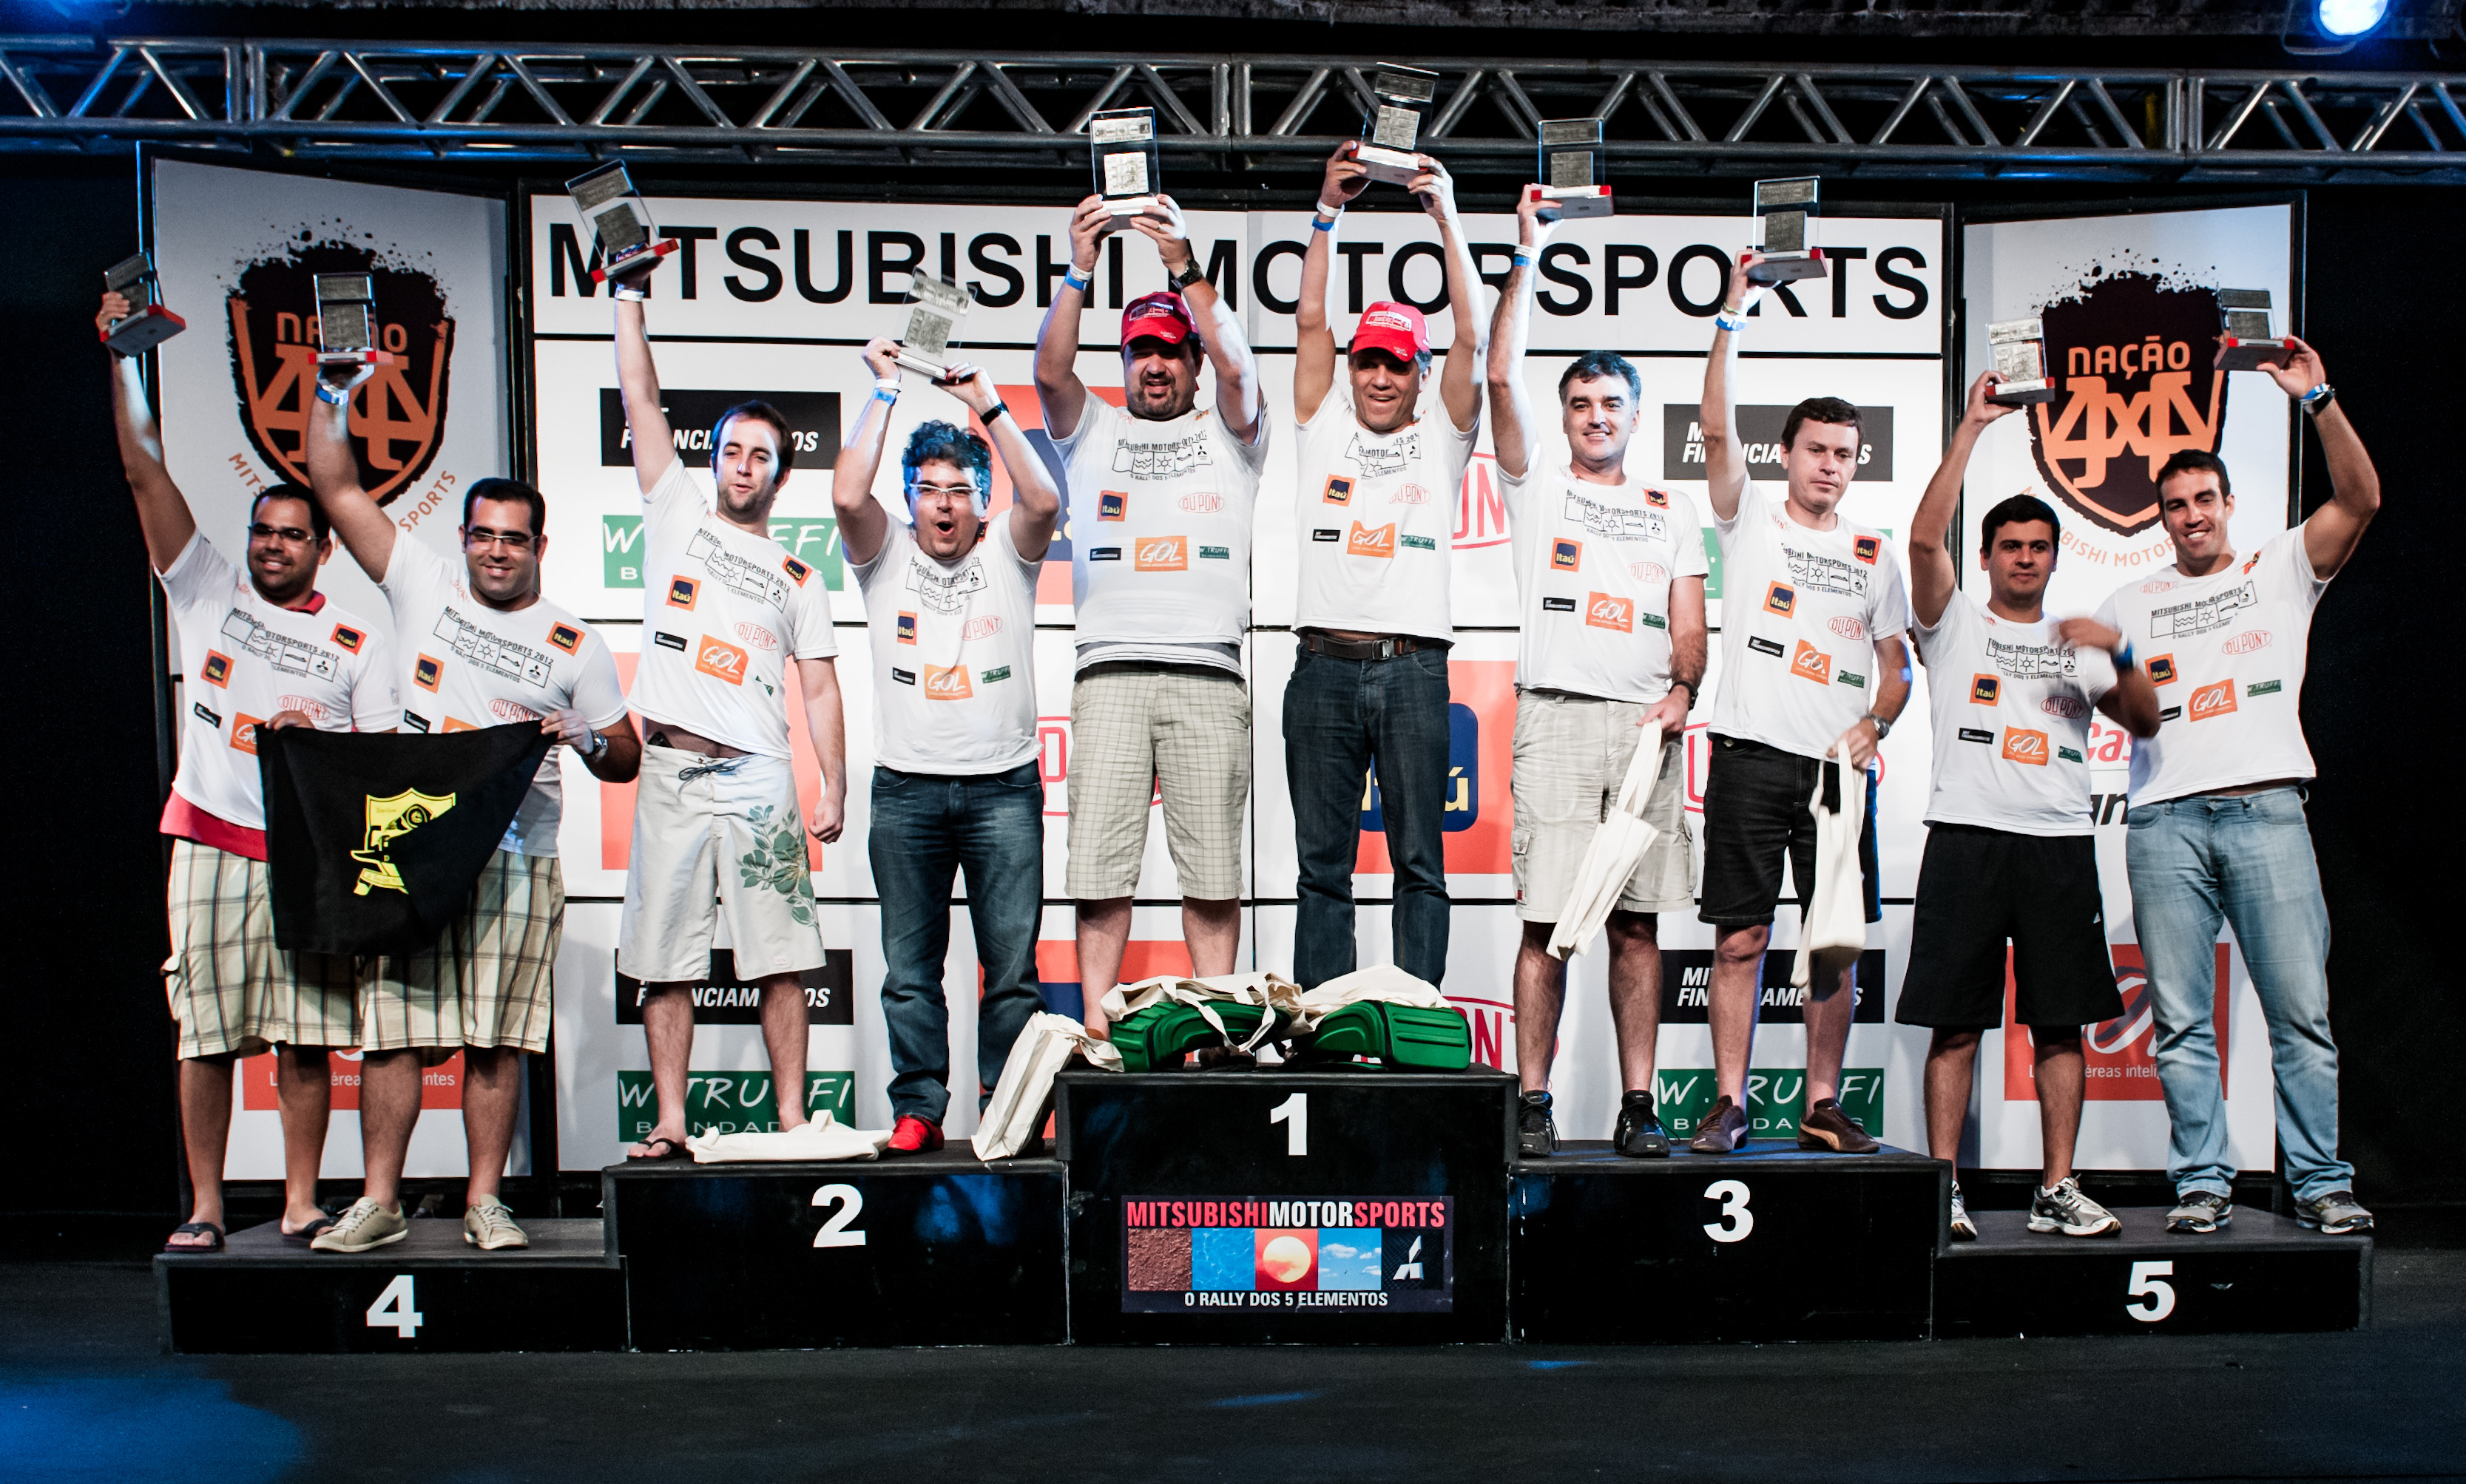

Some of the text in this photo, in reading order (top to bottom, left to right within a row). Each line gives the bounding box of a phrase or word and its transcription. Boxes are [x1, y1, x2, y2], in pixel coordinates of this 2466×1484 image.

[2068, 335, 2191, 380] NAÇÃO
[1328, 488, 1347, 499] Itaú
[1405, 484, 1428, 502] PONT
[1101, 504, 1121, 515] Itaú
[1352, 528, 1391, 548] GOL
[1139, 541, 1183, 563] GOL
[1555, 552, 1575, 564] Itaú
[1857, 547, 1874, 557] Itaú
[672, 589, 692, 603] Itaú
[1770, 596, 1791, 609] Itaú
[1591, 600, 1629, 623] GOL
[2150, 602, 2192, 617] MITSUBISHI
[2240, 631, 2269, 651] PONT
[702, 645, 741, 674] GOL
[927, 671, 967, 692] GOL
[2152, 668, 2172, 680] Itaú
[1976, 687, 1995, 698] Itaú
[2193, 686, 2232, 712] GOL
[2007, 734, 2045, 756] GOL
[2085, 1064, 2121, 1078] éreas
[1270, 1092, 1308, 1156] 1
[811, 1185, 867, 1248] 2
[1703, 1179, 1754, 1242] 3
[1184, 1292, 1388, 1307] O RALLY DOS 5 ELEMENTOS
[2125, 1261, 2177, 1322] 5
[365, 1275, 423, 1338] 4
